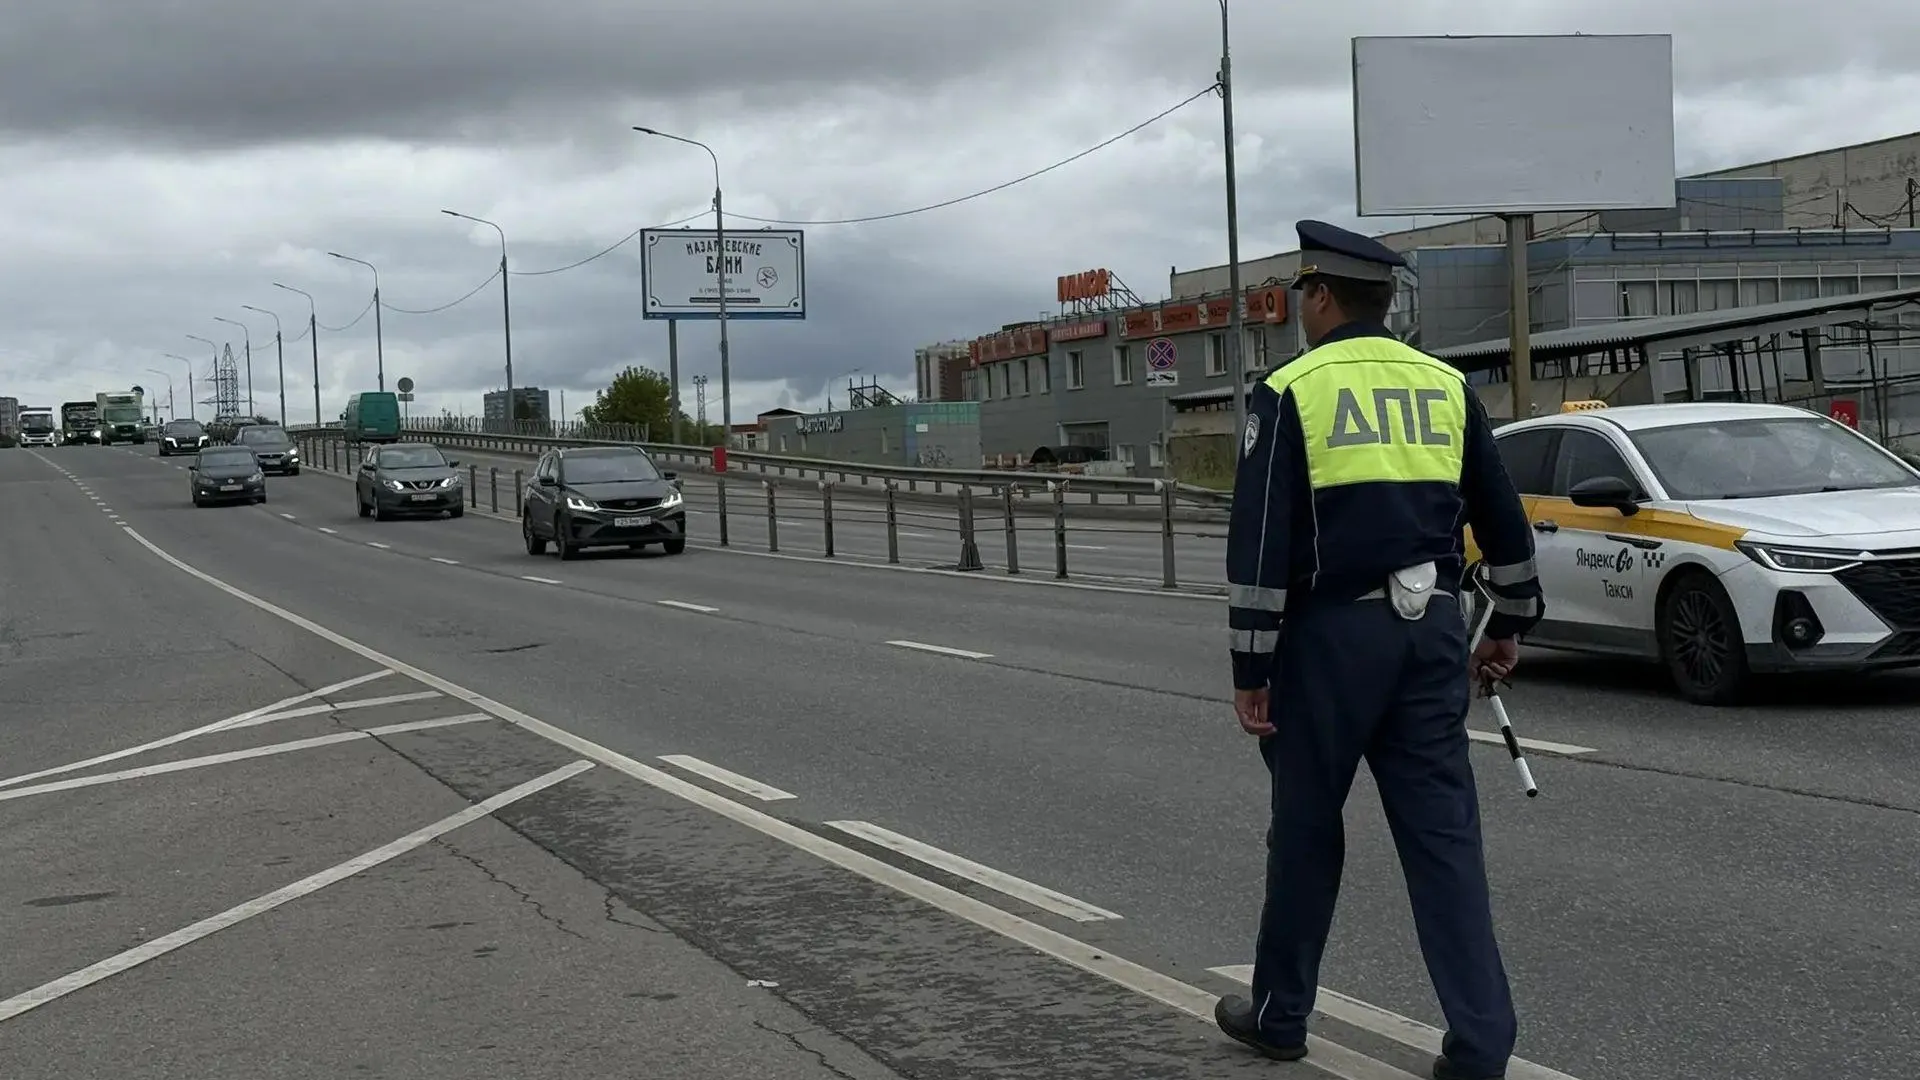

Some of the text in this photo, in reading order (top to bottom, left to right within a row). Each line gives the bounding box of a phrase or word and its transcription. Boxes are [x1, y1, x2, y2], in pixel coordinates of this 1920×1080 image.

[686, 239, 762, 256] НАЗАРЕВСКИЕ
[1326, 387, 1452, 449] ДПС
[1576, 547, 1634, 573] Яндекс Go
[1601, 579, 1634, 600] Такси
